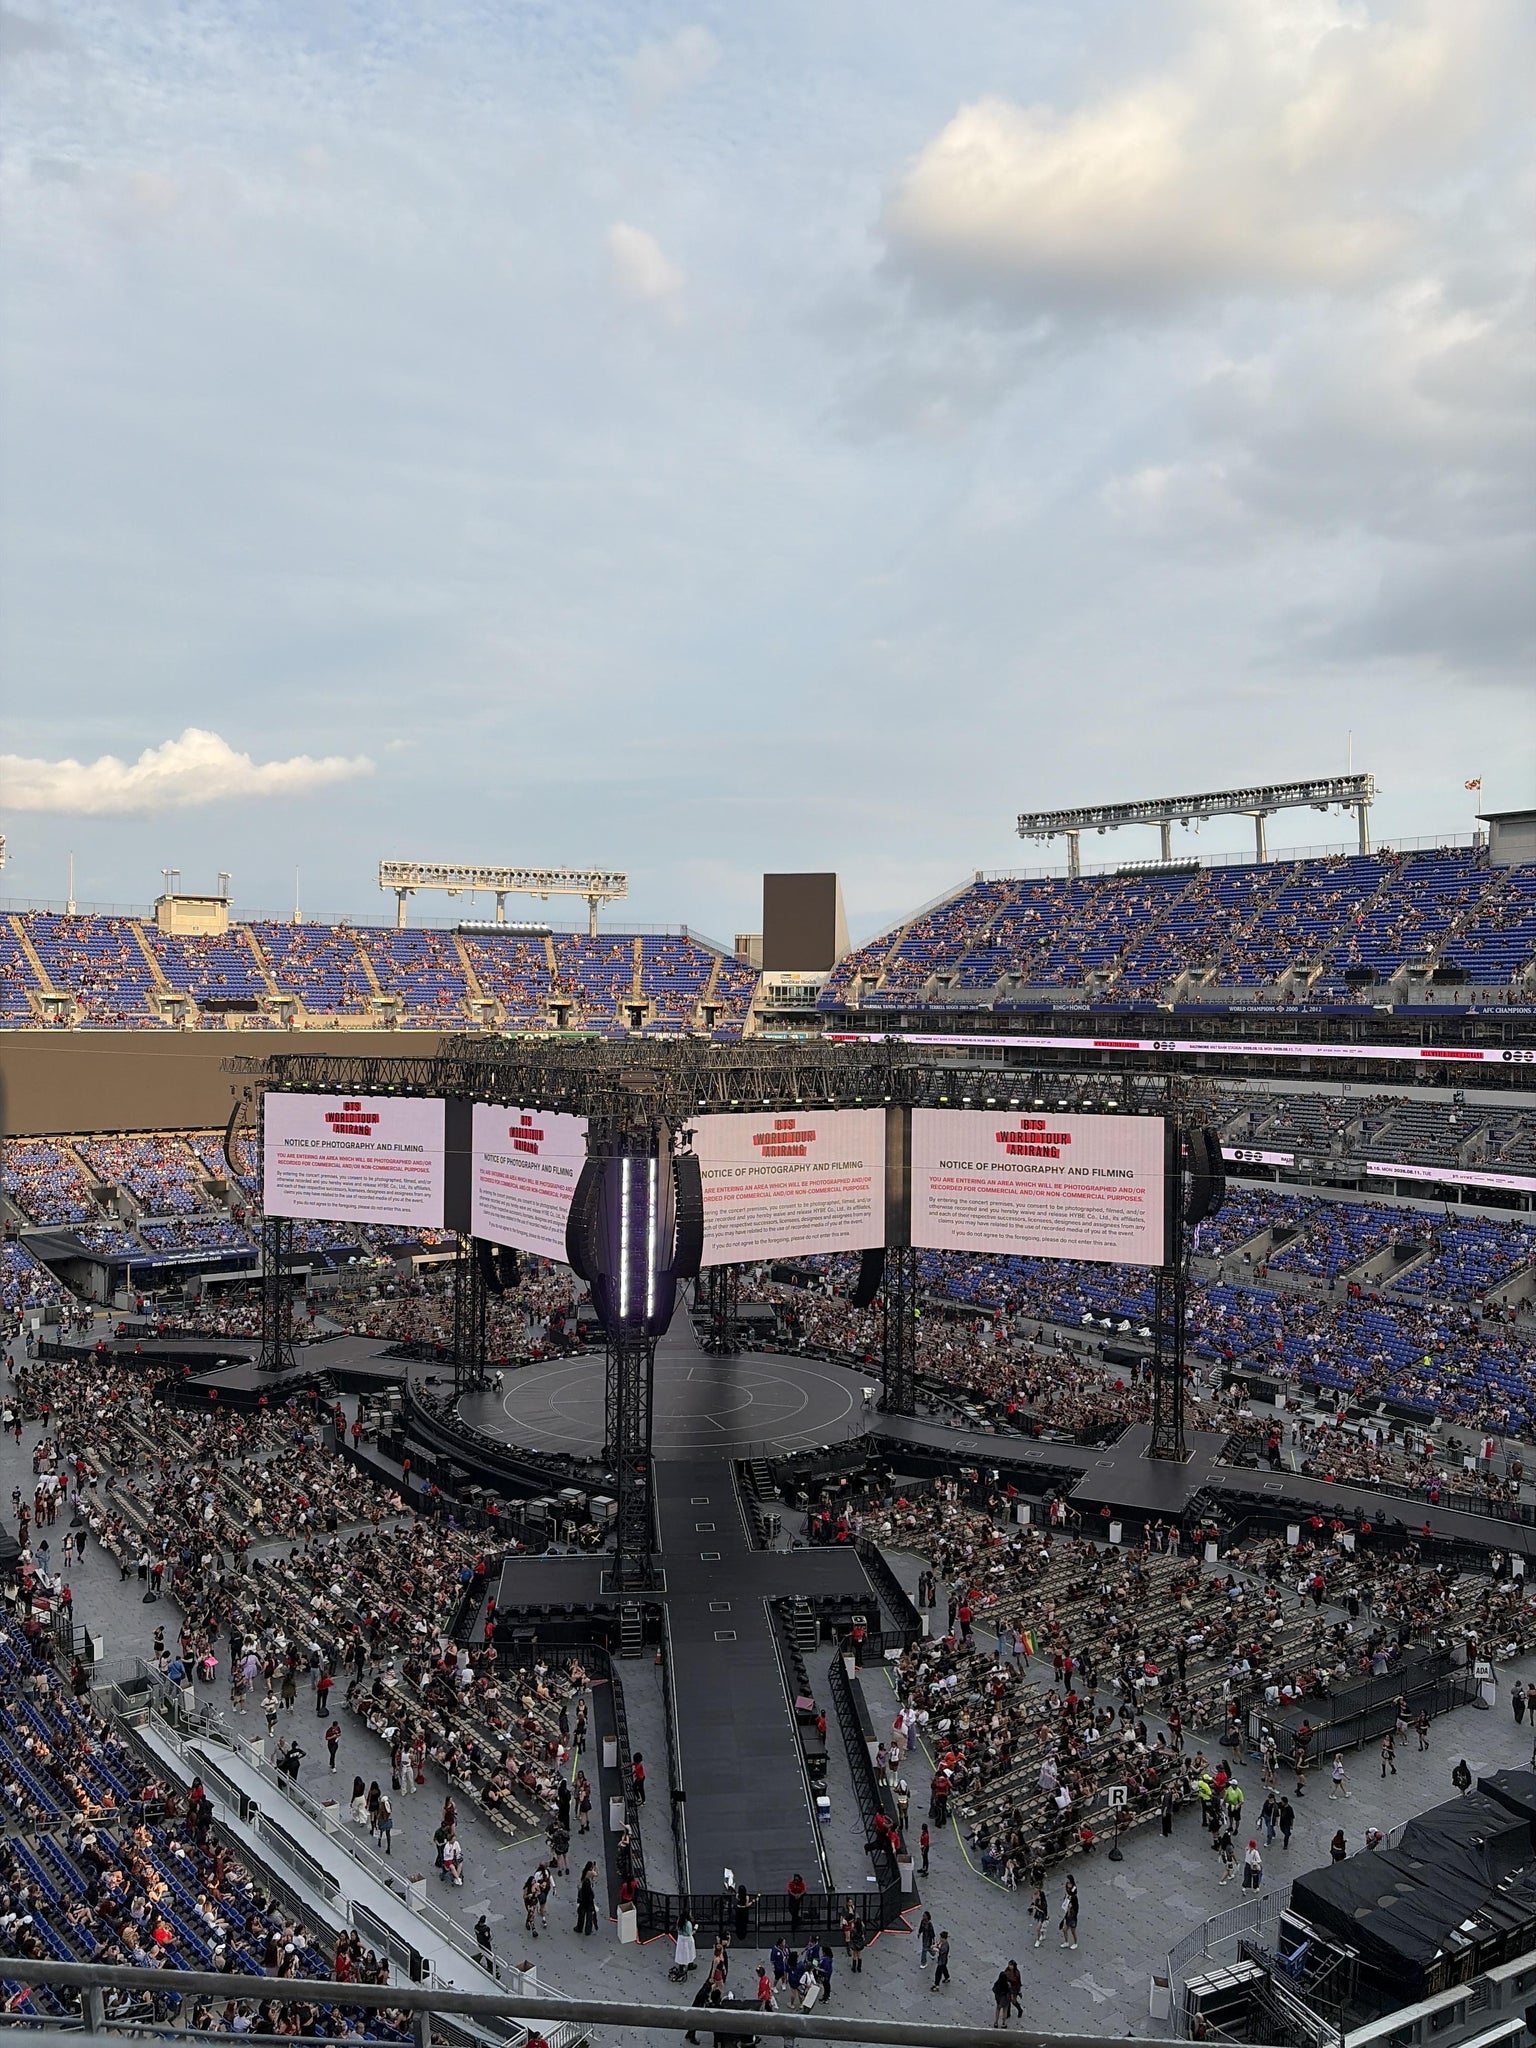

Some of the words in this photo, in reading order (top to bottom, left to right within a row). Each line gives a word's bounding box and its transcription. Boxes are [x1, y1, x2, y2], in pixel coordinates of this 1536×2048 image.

[328, 1112, 353, 1122] WORLD
[357, 1113, 376, 1123] TOUR
[335, 1124, 368, 1135] ARIRANG
[777, 1119, 792, 1130] BTS
[1024, 1119, 1042, 1130] BTS
[756, 1132, 786, 1144] WORLD
[790, 1130, 812, 1142] TOUR
[1000, 1131, 1035, 1143] WORLD
[1040, 1132, 1066, 1144] TOUR
[322, 1140, 374, 1149] PHOTOGRAPHY
[394, 1144, 423, 1152] FILMING
[765, 1144, 803, 1157] ARIRANG
[1010, 1144, 1056, 1157] ARIRANG
[484, 1153, 498, 1163] NOTICE
[500, 1156, 505, 1164] OF
[506, 1157, 540, 1171] PHOTOGRAPHY
[541, 1164, 551, 1173] AND
[553, 1166, 572, 1177] FILMING
[701, 1168, 732, 1178] NOTICE
[734, 1168, 746, 1176] OF
[748, 1164, 810, 1175] PHOTOGRAPHY
[812, 1162, 829, 1171] AND
[832, 1160, 862, 1169] FILMING
[939, 1160, 973, 1169] NOTICE
[991, 1163, 1064, 1174] PHOTOGRAPHY
[1068, 1167, 1088, 1175] AND
[1092, 1168, 1133, 1178] FILMING
[795, 1186, 841, 1195] NON-COMMERCIAL
[1064, 1184, 1116, 1192] PHOTOGRAPHED
[1046, 1191, 1104, 1199] NON-COMMERCIAL
[1113, 1790, 1124, 1804] R
